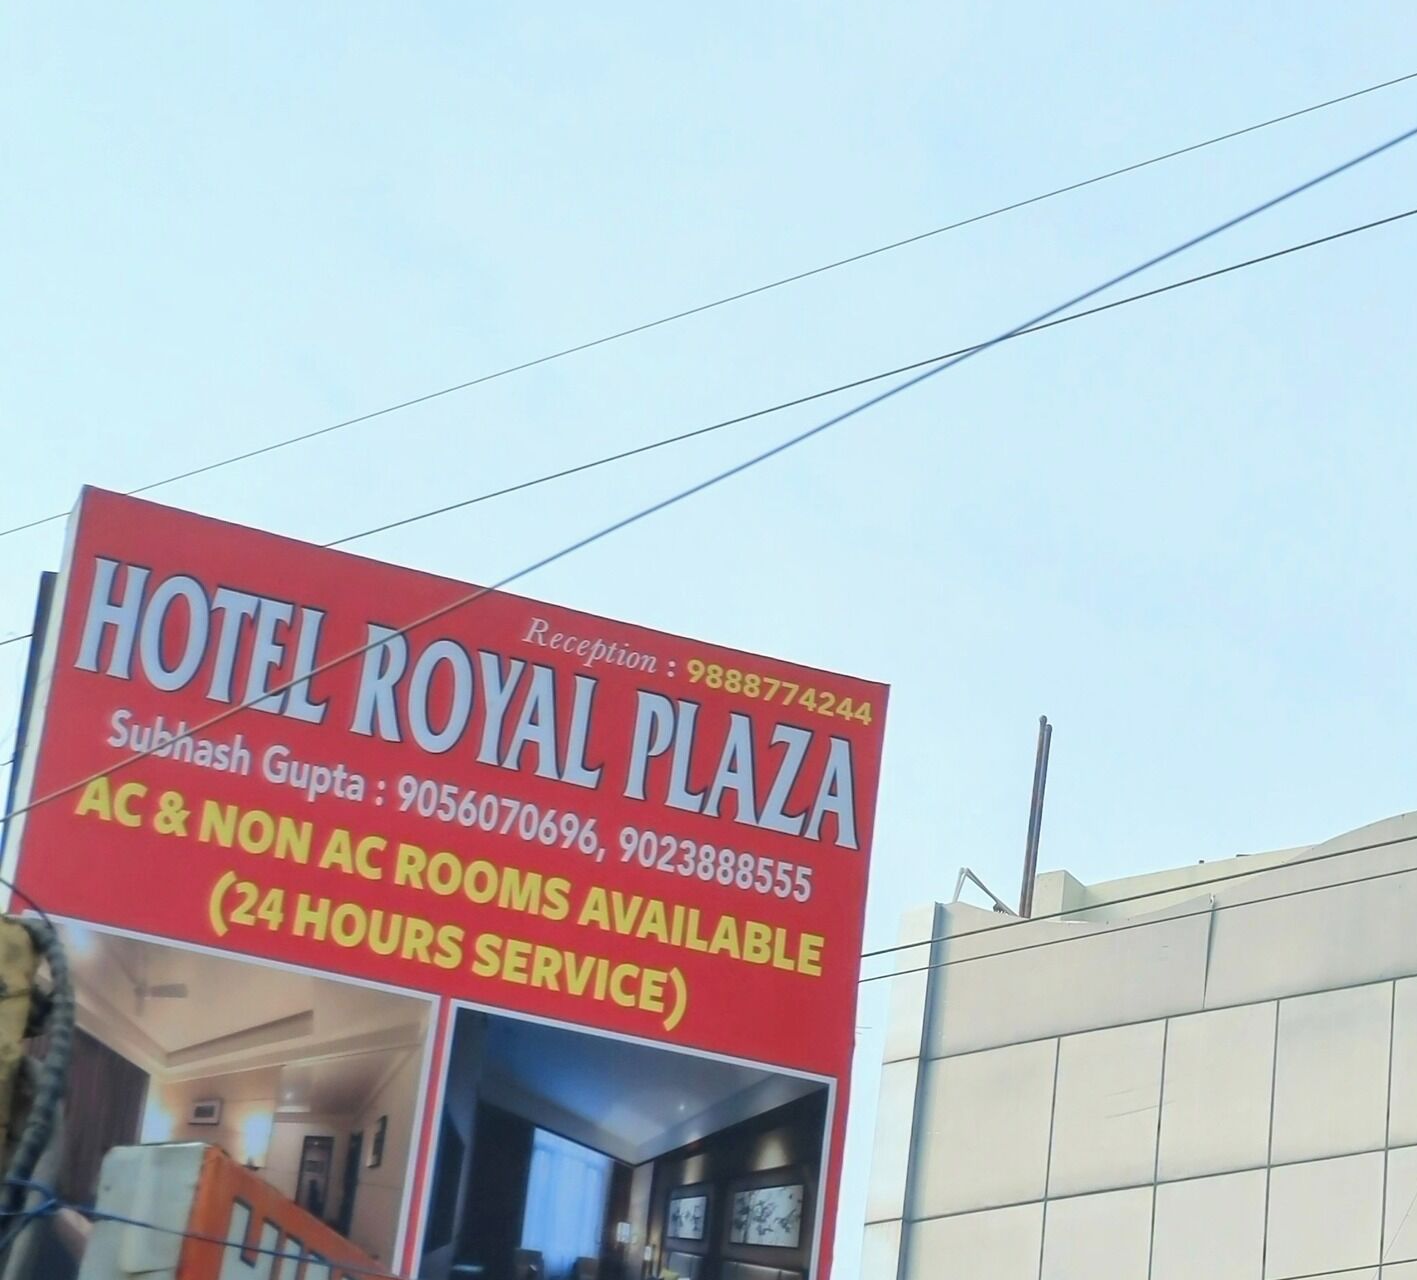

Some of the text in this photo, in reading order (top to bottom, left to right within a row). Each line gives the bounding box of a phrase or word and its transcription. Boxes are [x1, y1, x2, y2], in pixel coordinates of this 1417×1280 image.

[74, 556, 861, 851] HOTEL ROYAL PLAZA
[522, 617, 659, 674] Reception
[687, 658, 873, 726] 9888774244
[75, 776, 825, 978] AC & NON AC ROOMS AVAILABLE
[107, 708, 251, 776] Subhash
[262, 745, 366, 802] Gupta
[398, 774, 606, 863] 9056070696,
[618, 826, 813, 904] 9023888555
[208, 870, 688, 1032] (24 HOURS SERVICE)
